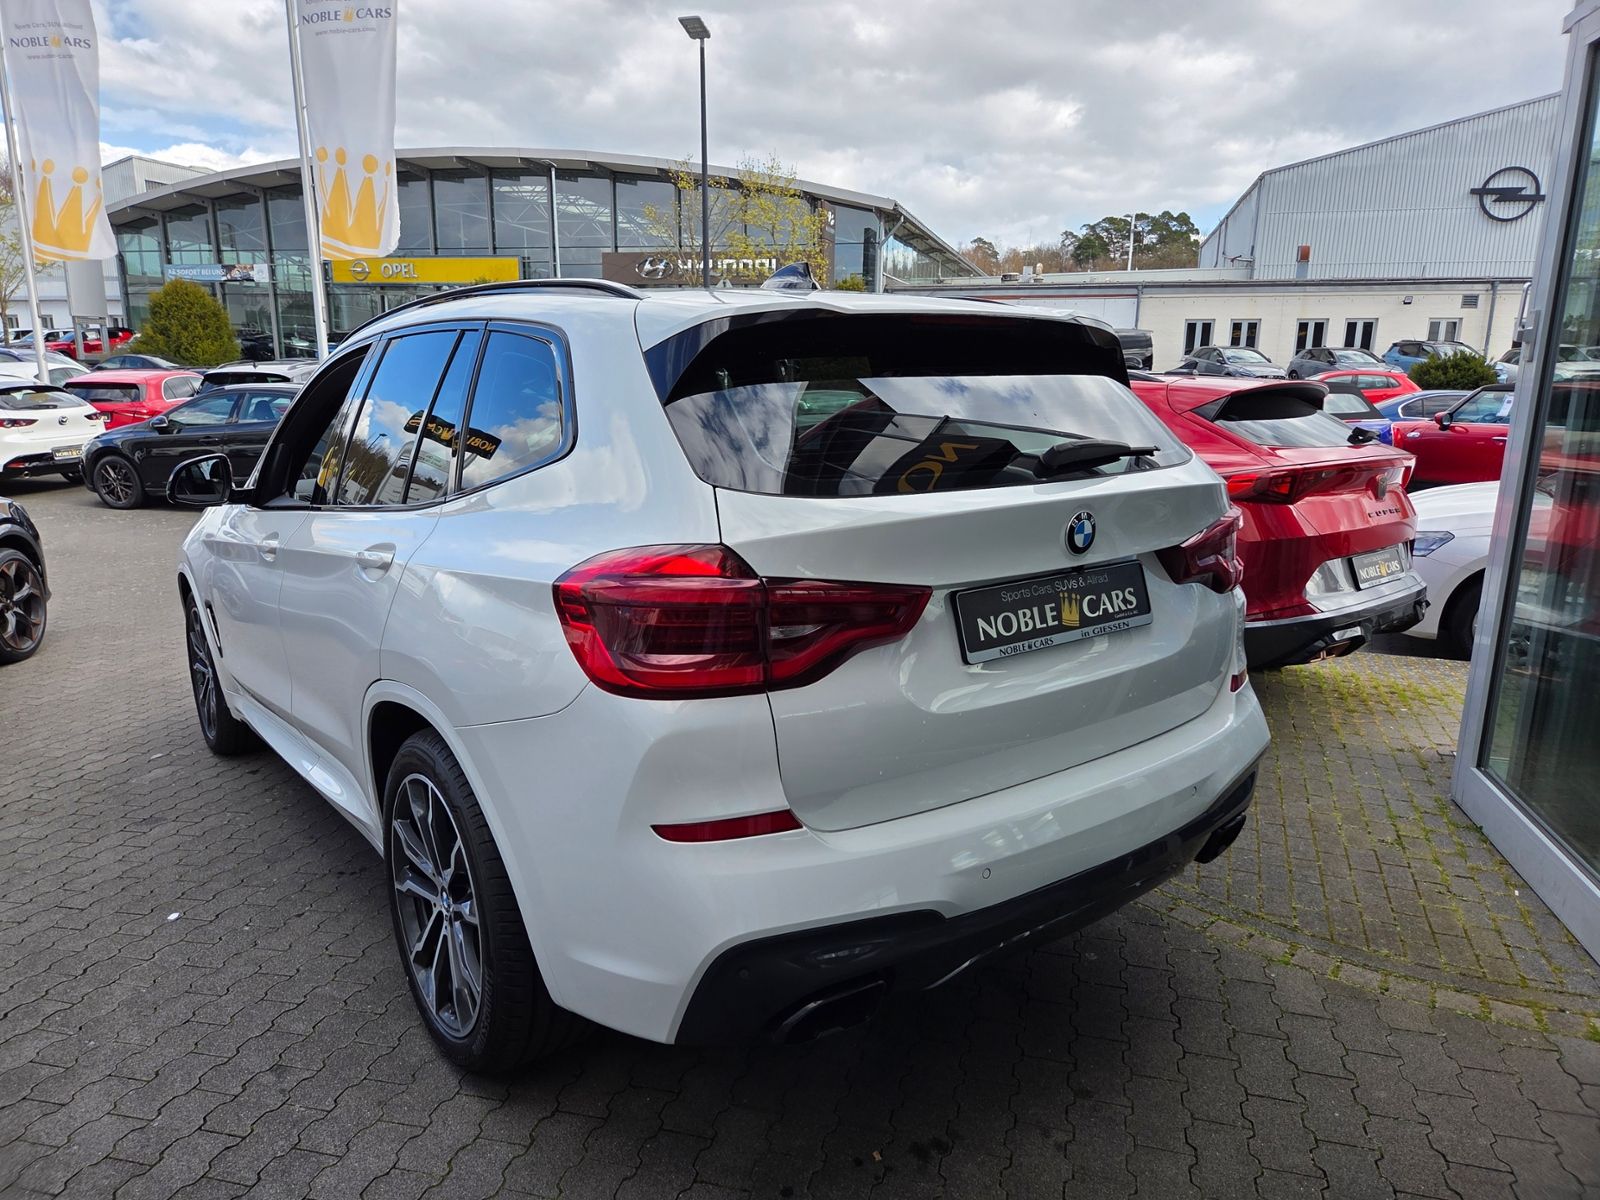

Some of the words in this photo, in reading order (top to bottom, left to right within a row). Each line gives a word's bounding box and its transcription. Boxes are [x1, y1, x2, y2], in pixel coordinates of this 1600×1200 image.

[302, 10, 341, 25] NOBLE
[356, 7, 392, 19] CARS
[10, 36, 49, 48] NOBLE
[64, 36, 91, 49] ARS
[381, 262, 418, 278] OPEL
[1359, 564, 1381, 580] NOBLE
[1385, 560, 1400, 573] CARS
[1000, 587, 1031, 603] Sports
[1054, 578, 1078, 591] SUVs
[1078, 576, 1086, 587] &
[1086, 573, 1109, 586] Allrad
[977, 603, 1059, 641] NOBLE
[1082, 587, 1137, 618] CARS
[1081, 629, 1090, 638] in
[1093, 621, 1130, 635] GIESSEN
[999, 644, 1026, 656] NOBLE
[1034, 637, 1054, 651] CARS
